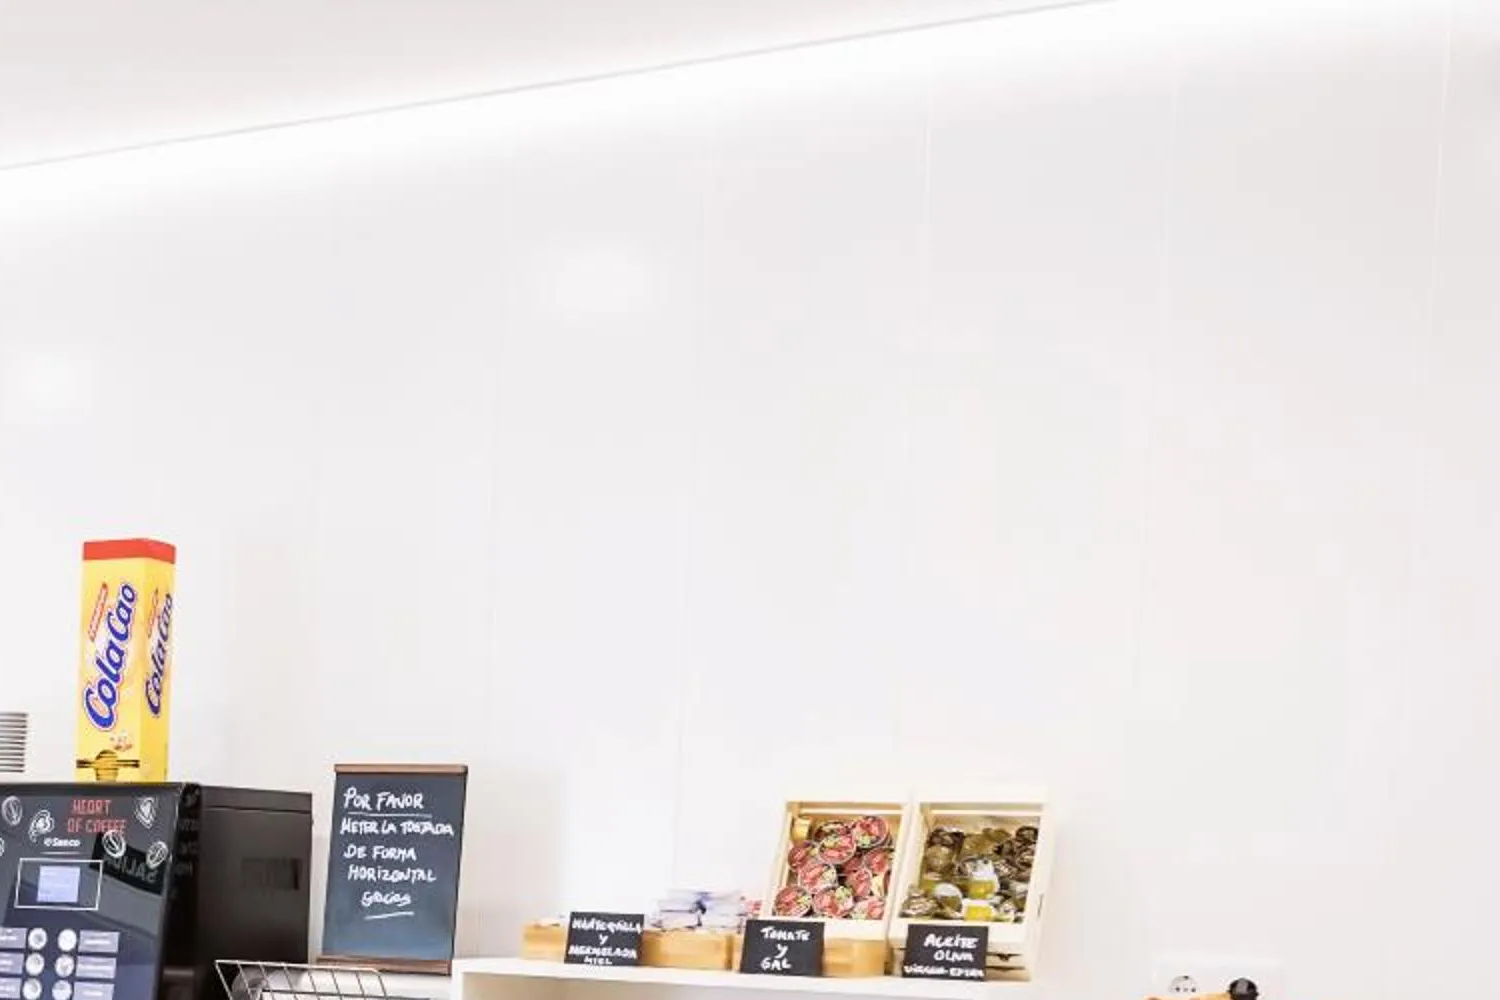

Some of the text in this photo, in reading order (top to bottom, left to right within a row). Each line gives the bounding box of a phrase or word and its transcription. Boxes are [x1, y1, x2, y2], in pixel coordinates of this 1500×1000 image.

[343, 787, 424, 811] POR FAVOR
[67, 819, 83, 833] OF
[343, 844, 417, 861] DE FORMA
